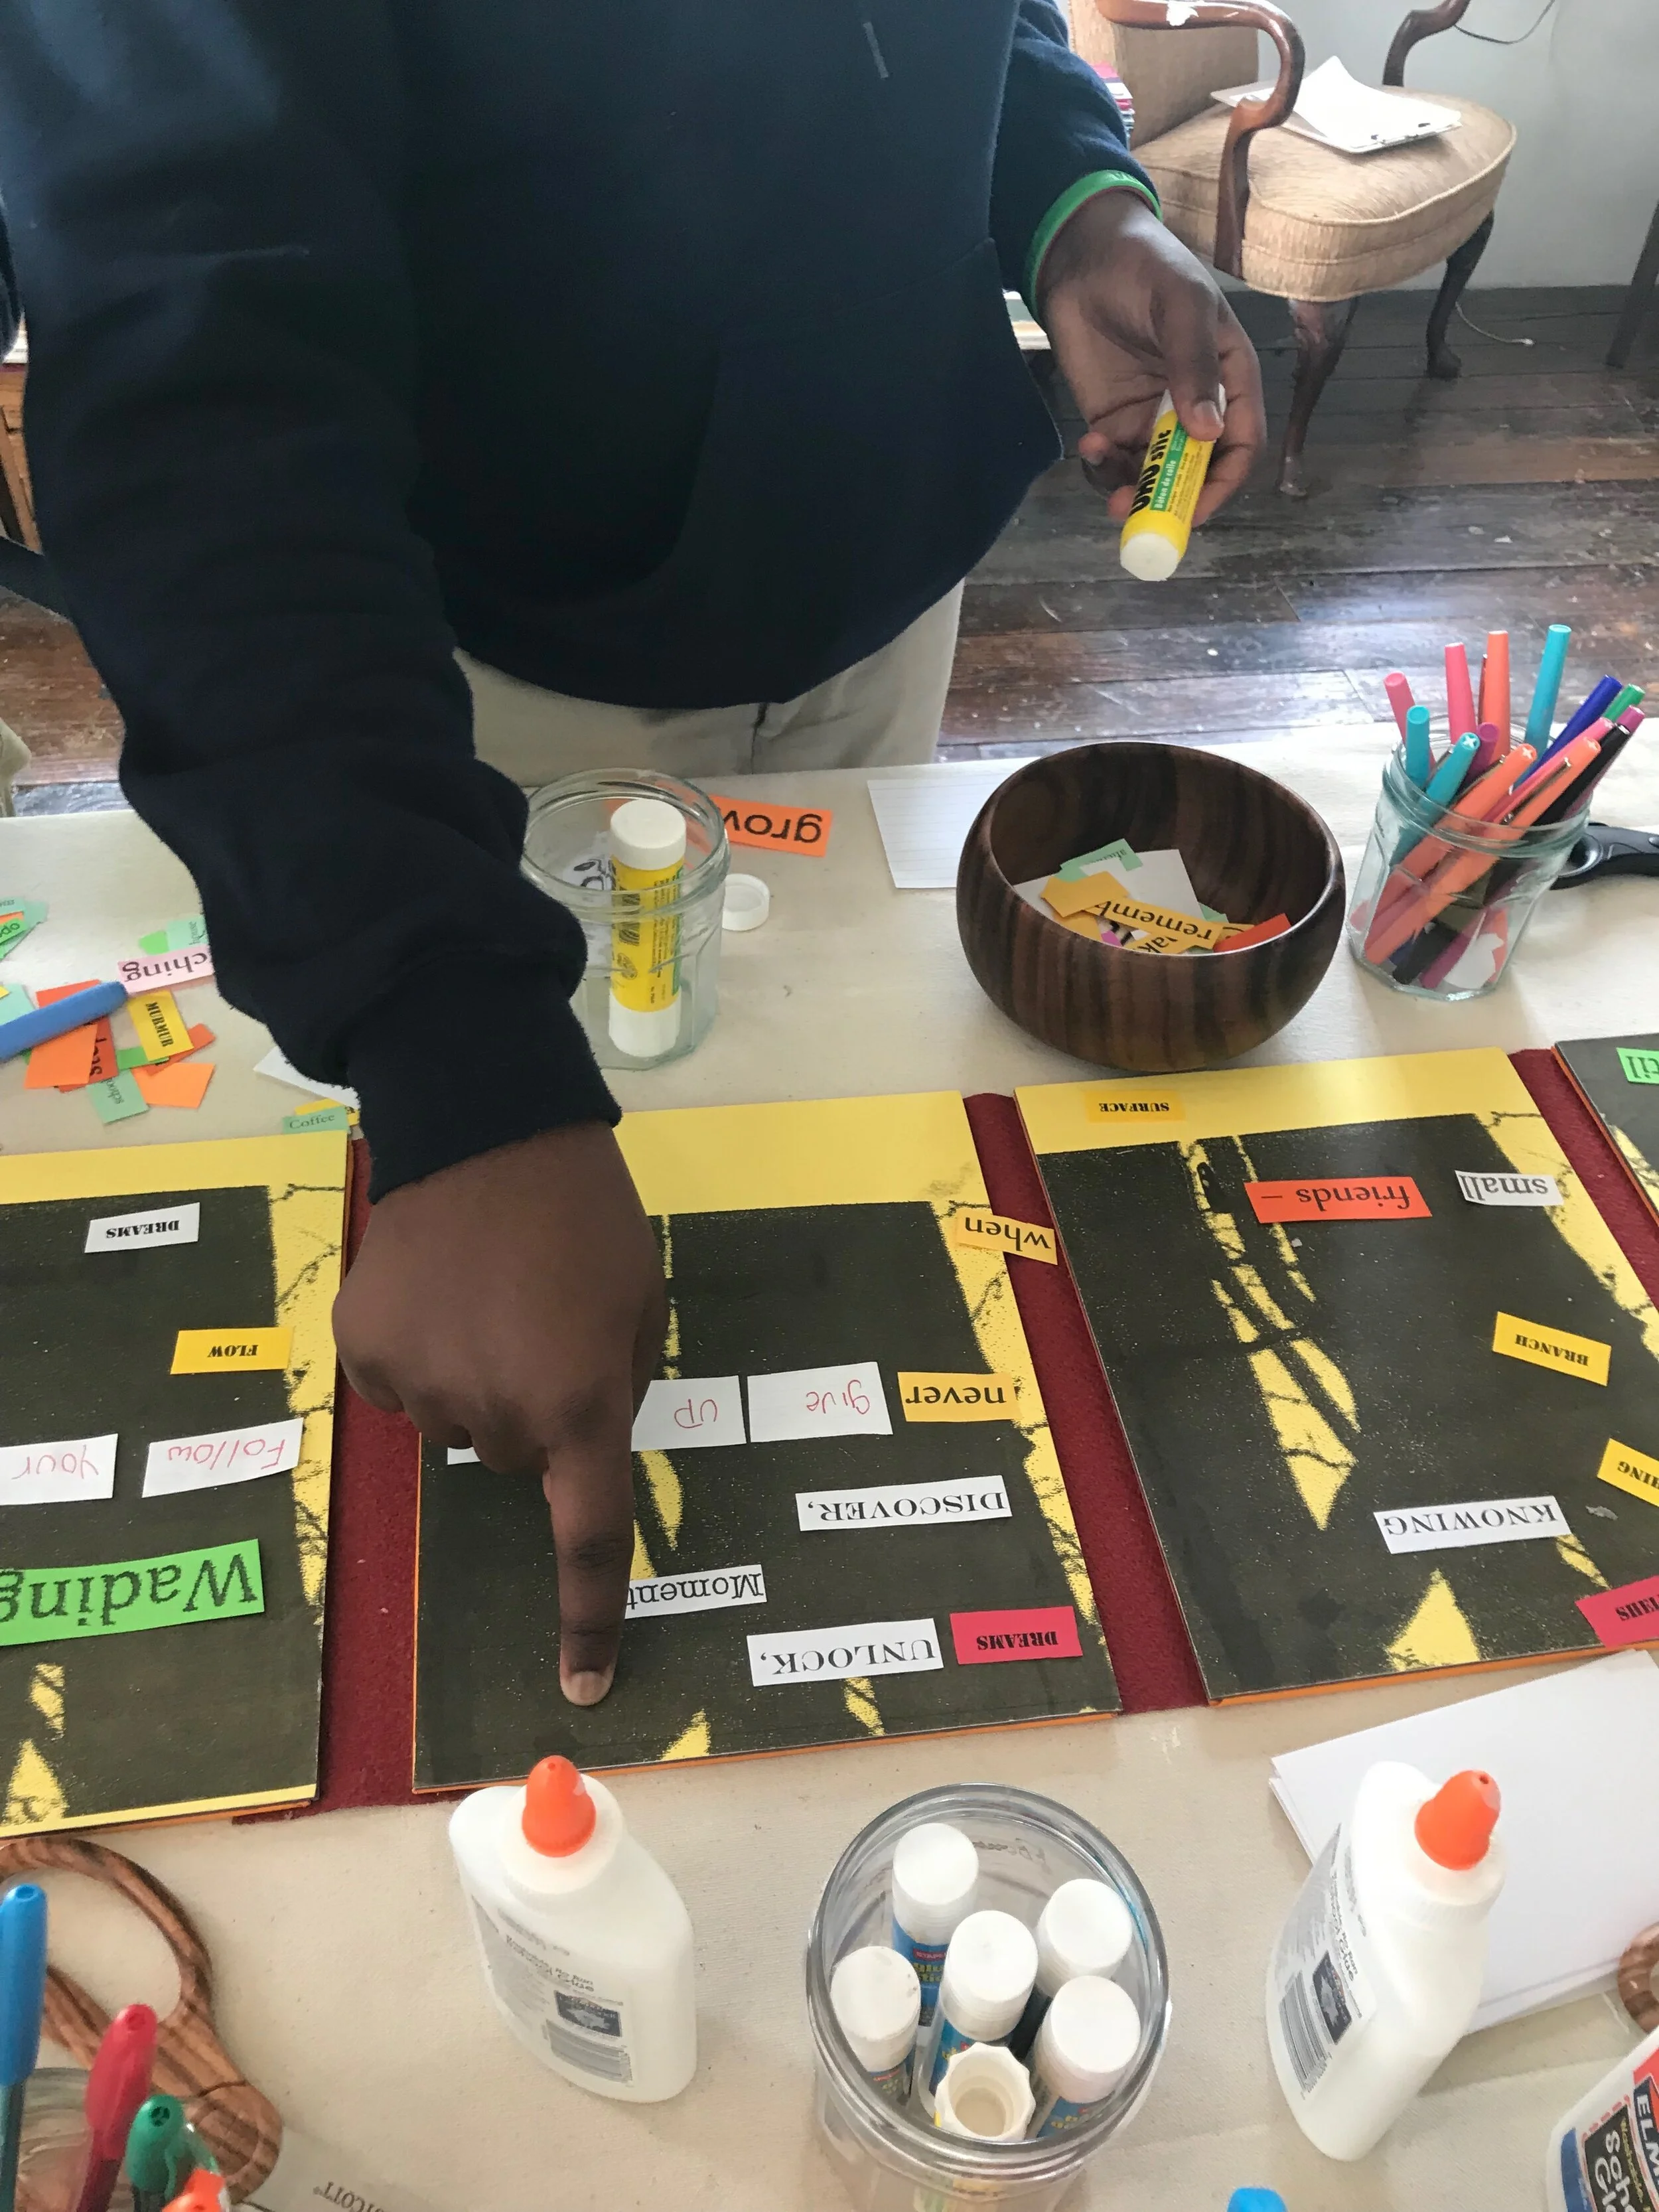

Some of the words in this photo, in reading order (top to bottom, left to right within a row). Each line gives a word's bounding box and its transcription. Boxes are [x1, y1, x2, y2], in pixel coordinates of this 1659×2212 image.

[1165, 459, 1177, 477] colle
[145, 1001, 175, 1047] MURMUR
[289, 1114, 336, 1130] Coffee
[1099, 1102, 1169, 1113] SURFACE
[1295, 1185, 1410, 1211] friends
[1461, 1175, 1548, 1202] small
[106, 1220, 180, 1239] DREAMS
[965, 1217, 1051, 1251] when
[208, 1344, 258, 1358] FLOW
[1516, 1334, 1589, 1366] BRANCH
[806, 1379, 870, 1414] give
[906, 1386, 1006, 1404] never
[11, 1444, 99, 1479] your
[167, 1439, 285, 1469] Follow
[808, 1491, 1007, 1521] DISCOVER,
[1382, 1503, 1558, 1535] KNOWING
[0, 1553, 257, 1626] Wading
[977, 1631, 1059, 1651] DREAMS
[760, 1639, 936, 1675] UNLOCK,
[1636, 2094, 1659, 2187] ELM
